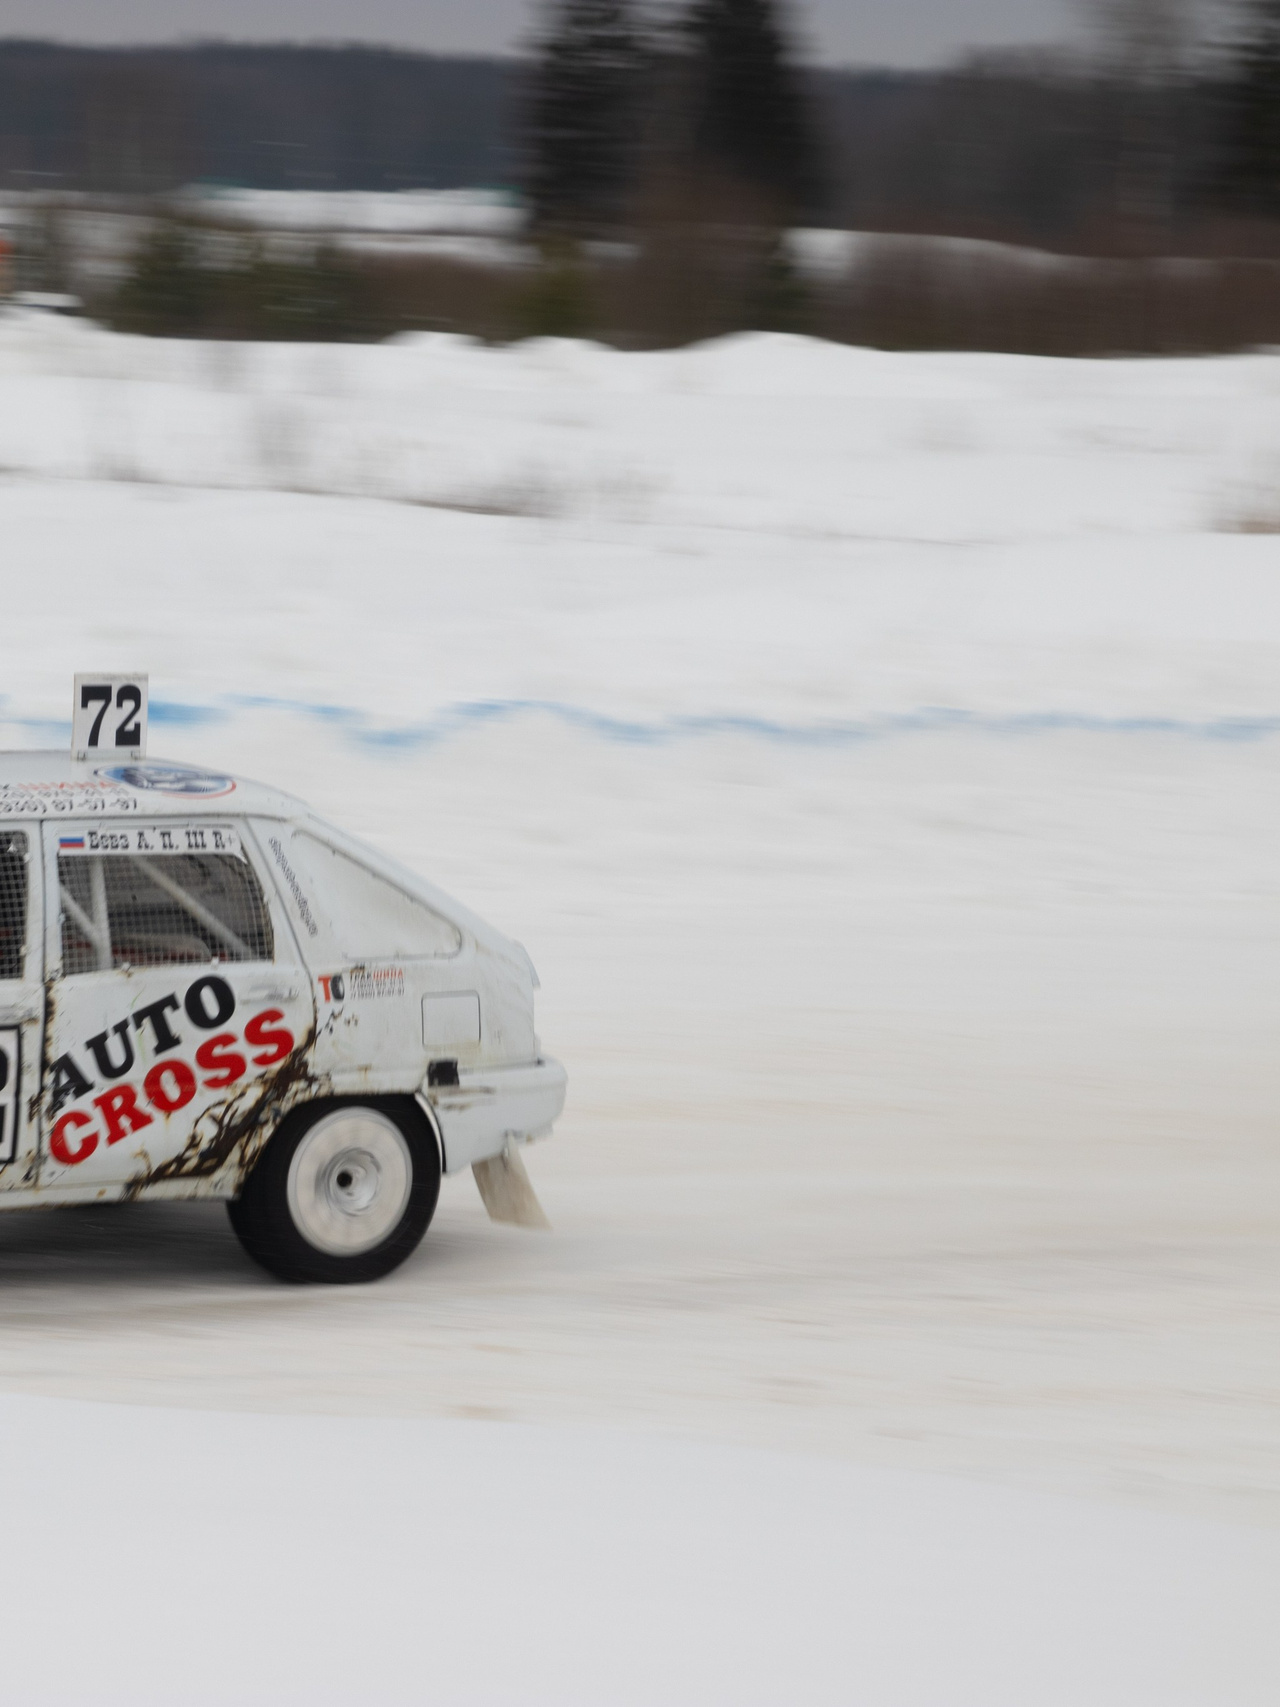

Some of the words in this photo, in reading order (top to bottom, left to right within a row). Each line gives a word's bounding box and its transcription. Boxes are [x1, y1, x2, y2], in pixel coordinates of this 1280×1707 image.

[81, 684, 141, 747] 72
[47, 974, 236, 1112] AUTO
[50, 1007, 295, 1166] CROSS
